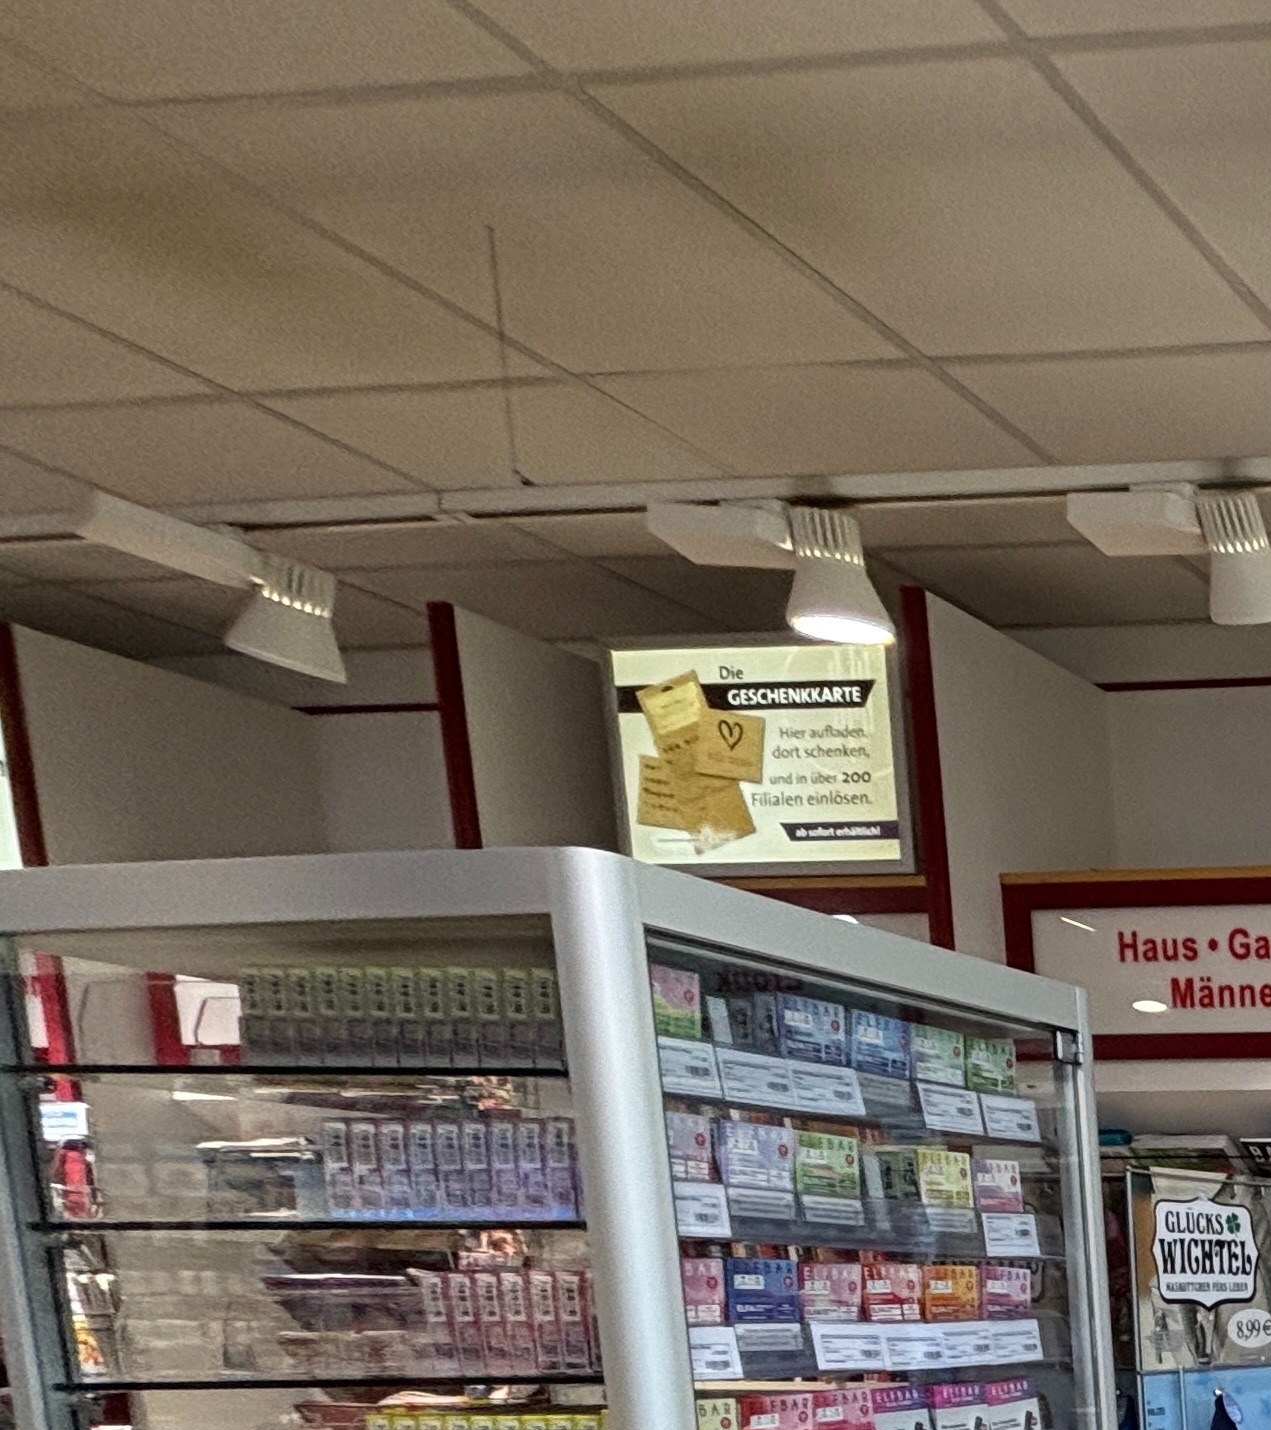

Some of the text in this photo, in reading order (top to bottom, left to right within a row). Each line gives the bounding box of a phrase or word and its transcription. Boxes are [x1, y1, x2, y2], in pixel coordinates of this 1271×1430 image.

[719, 665, 744, 681] Die
[727, 686, 862, 707] GESCHENKKARTE
[779, 725, 806, 740] Hier
[772, 745, 871, 761] dort schenken,
[770, 771, 872, 785] und in über 200
[751, 792, 873, 808] Filialen einlösen.
[1118, 931, 1198, 963] Haus
[1165, 1210, 1224, 1235] GLÜCKS
[1159, 1237, 1253, 1276] WICHTEL
